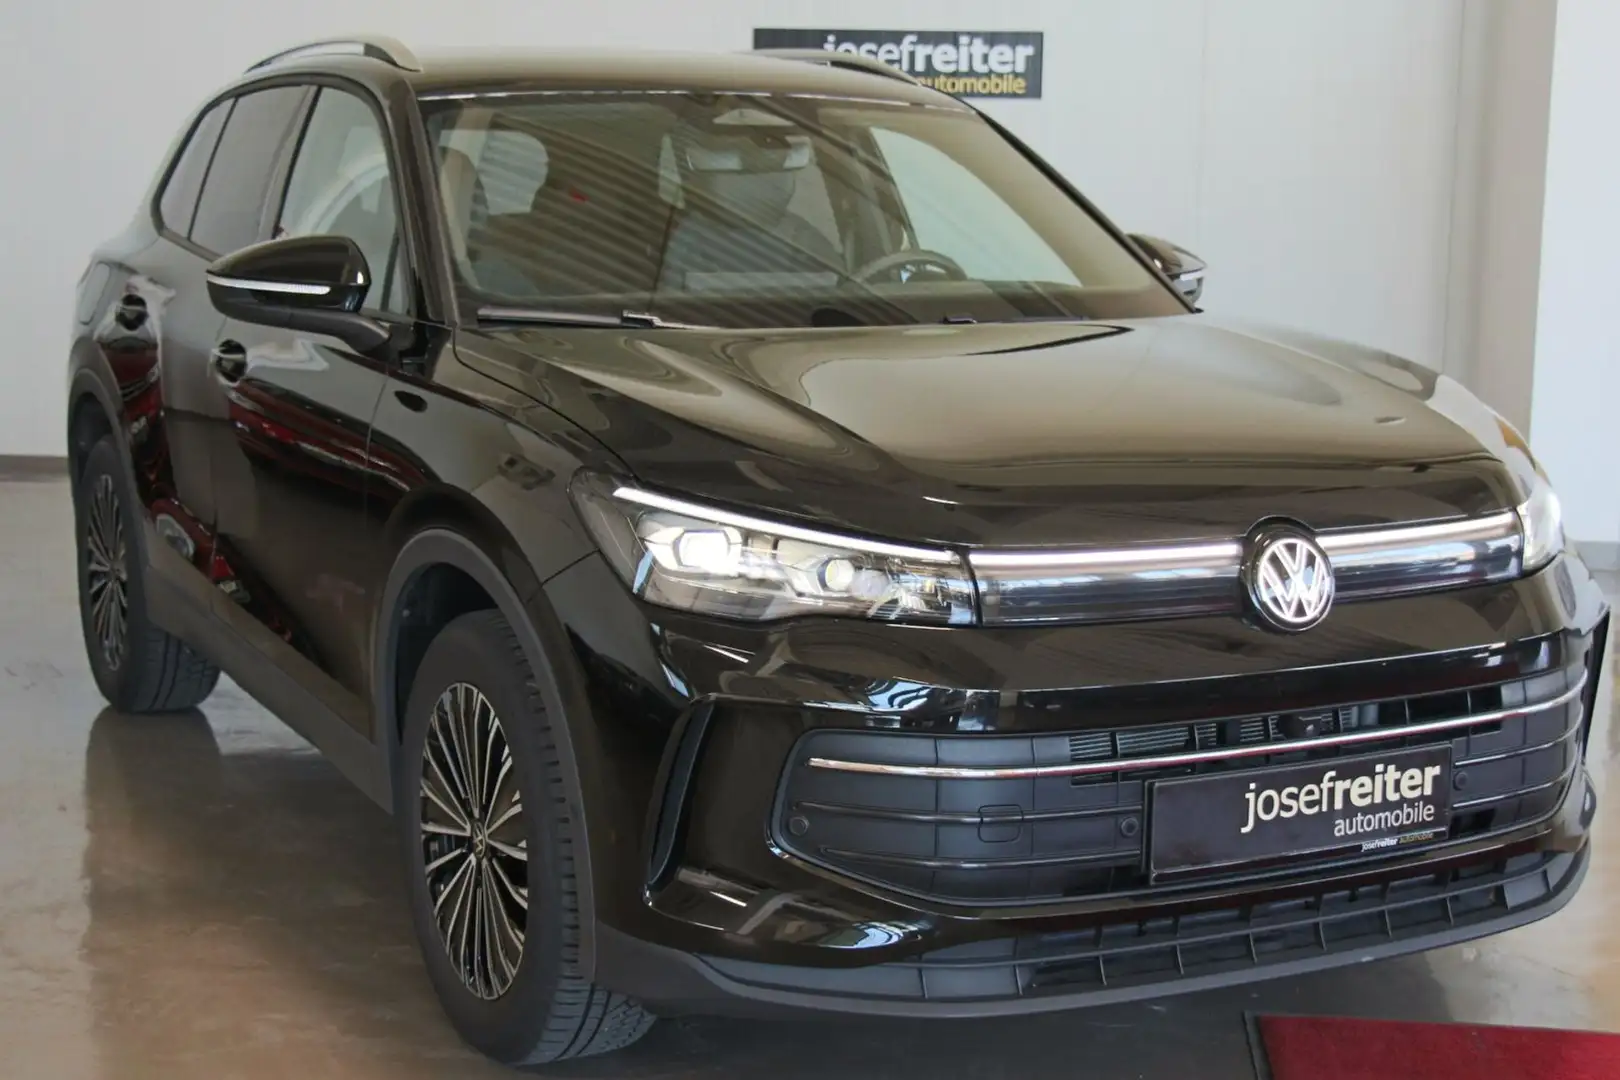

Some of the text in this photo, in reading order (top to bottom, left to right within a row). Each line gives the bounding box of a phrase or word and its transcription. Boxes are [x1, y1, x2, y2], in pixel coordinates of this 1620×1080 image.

[1258, 539, 1328, 623] VW
[1240, 764, 1441, 833] josefreiter
[1334, 801, 1435, 837] automobile
